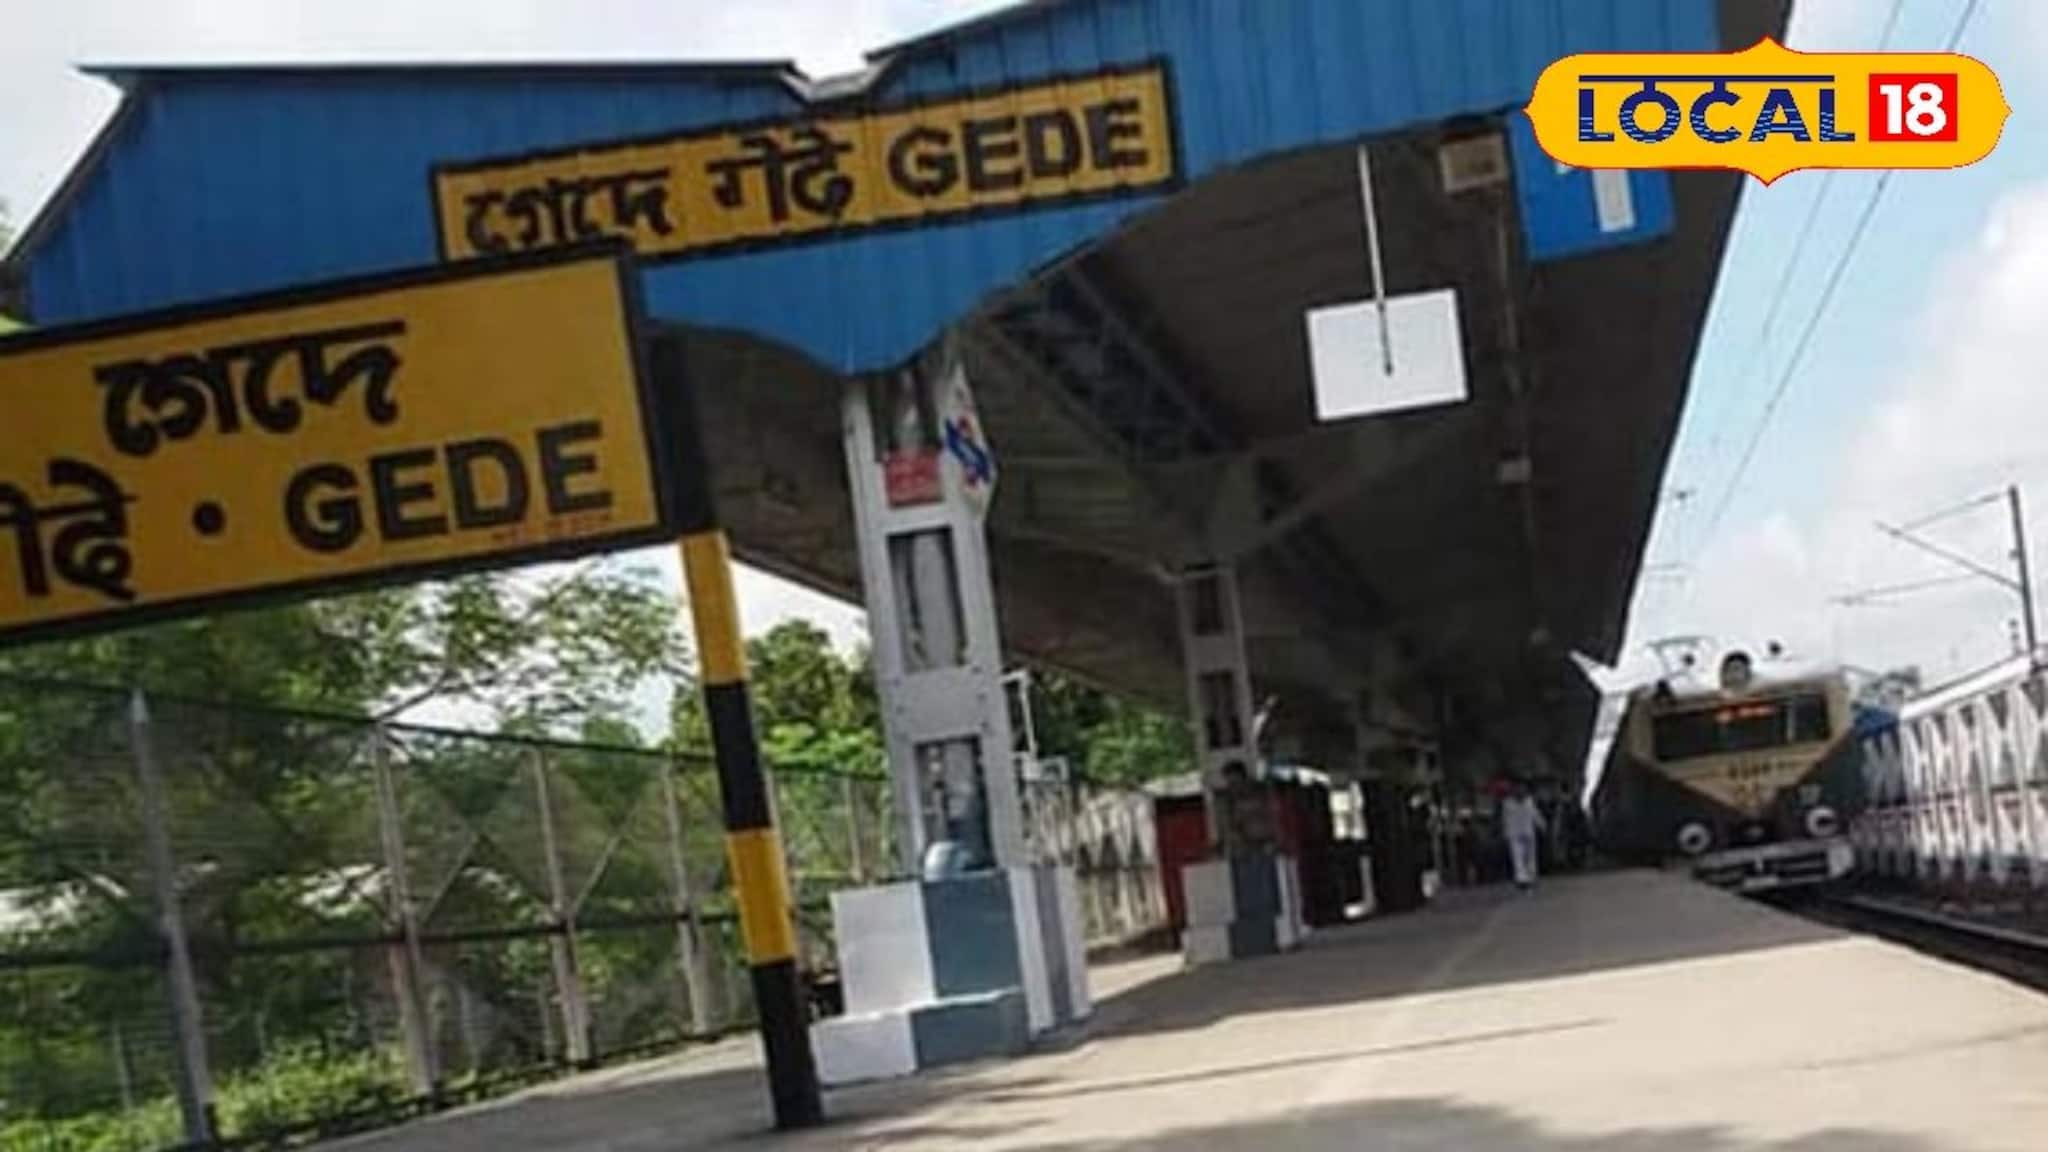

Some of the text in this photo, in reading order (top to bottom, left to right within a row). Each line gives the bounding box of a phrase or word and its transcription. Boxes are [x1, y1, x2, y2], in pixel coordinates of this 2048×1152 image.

[887, 95, 1150, 198] GEDE
[94, 320, 405, 458] গেদে
[284, 420, 613, 553] GEDE
